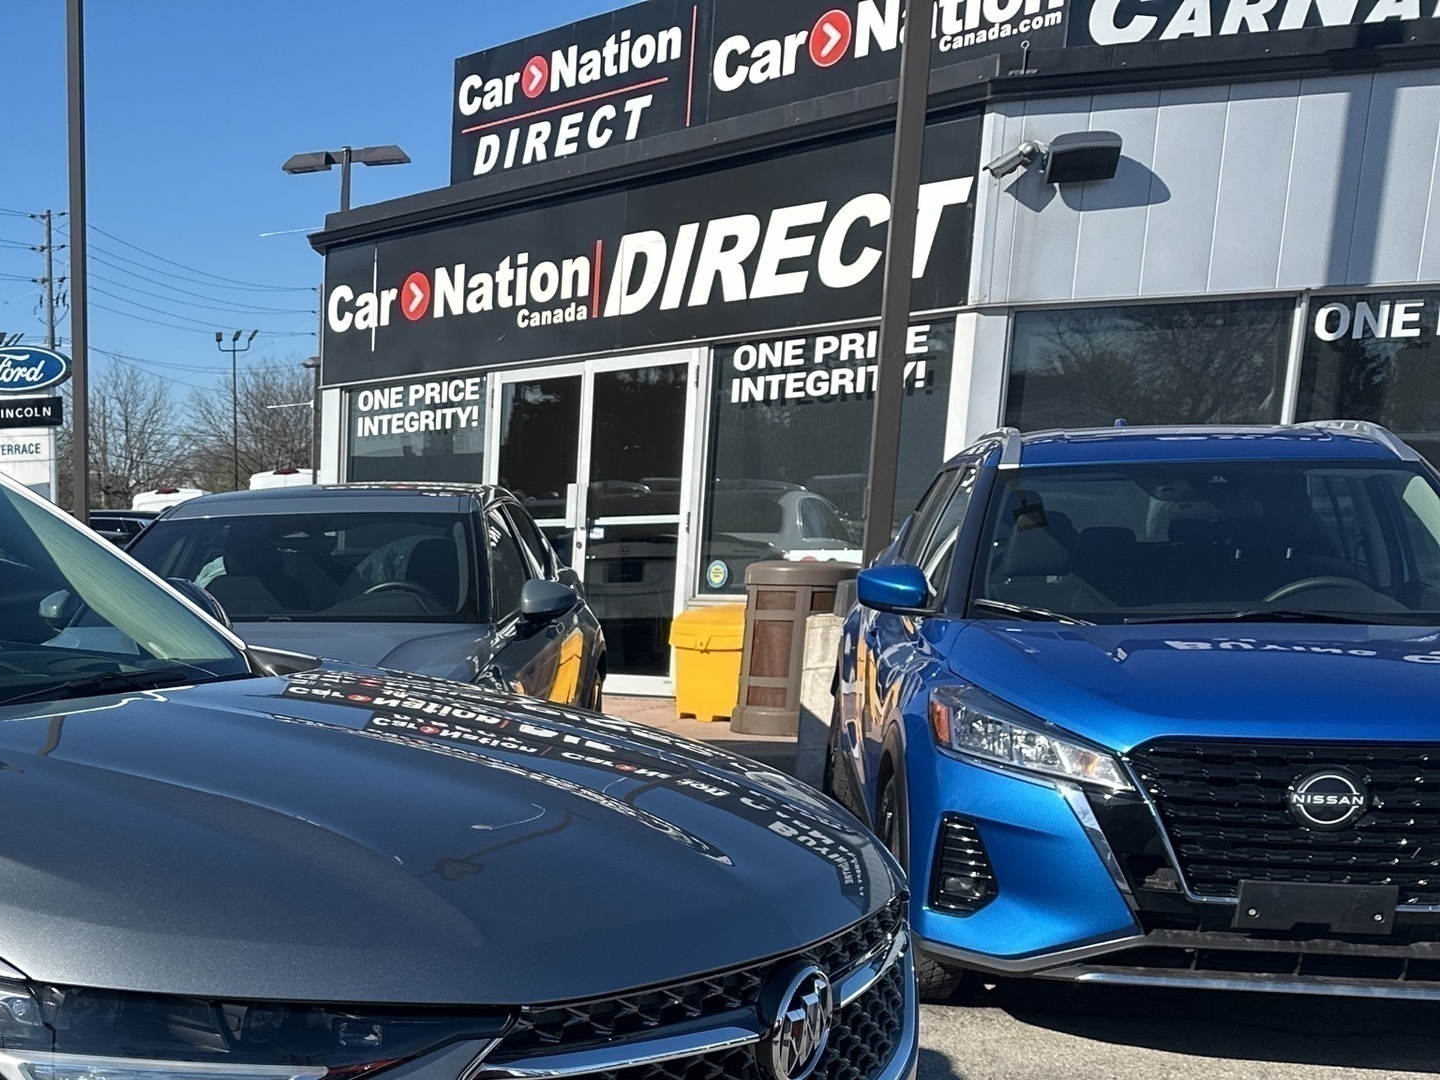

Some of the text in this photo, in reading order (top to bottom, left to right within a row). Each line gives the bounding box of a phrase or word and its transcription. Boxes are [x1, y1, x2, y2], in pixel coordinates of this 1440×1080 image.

[854, 0, 1064, 58] Ntio
[938, 10, 1062, 52] Canada.com
[1089, 0, 1440, 46] CARNA
[473, 94, 653, 176] DIRECT
[603, 180, 974, 318] DIRECT
[517, 302, 588, 328] Canada
[1315, 299, 1424, 341] ONE
[733, 325, 930, 371] ONE PRIE
[357, 379, 480, 412] ONE PRICE
[356, 406, 480, 437] INTEGRITY!
[1292, 793, 1364, 805] NISSAN
